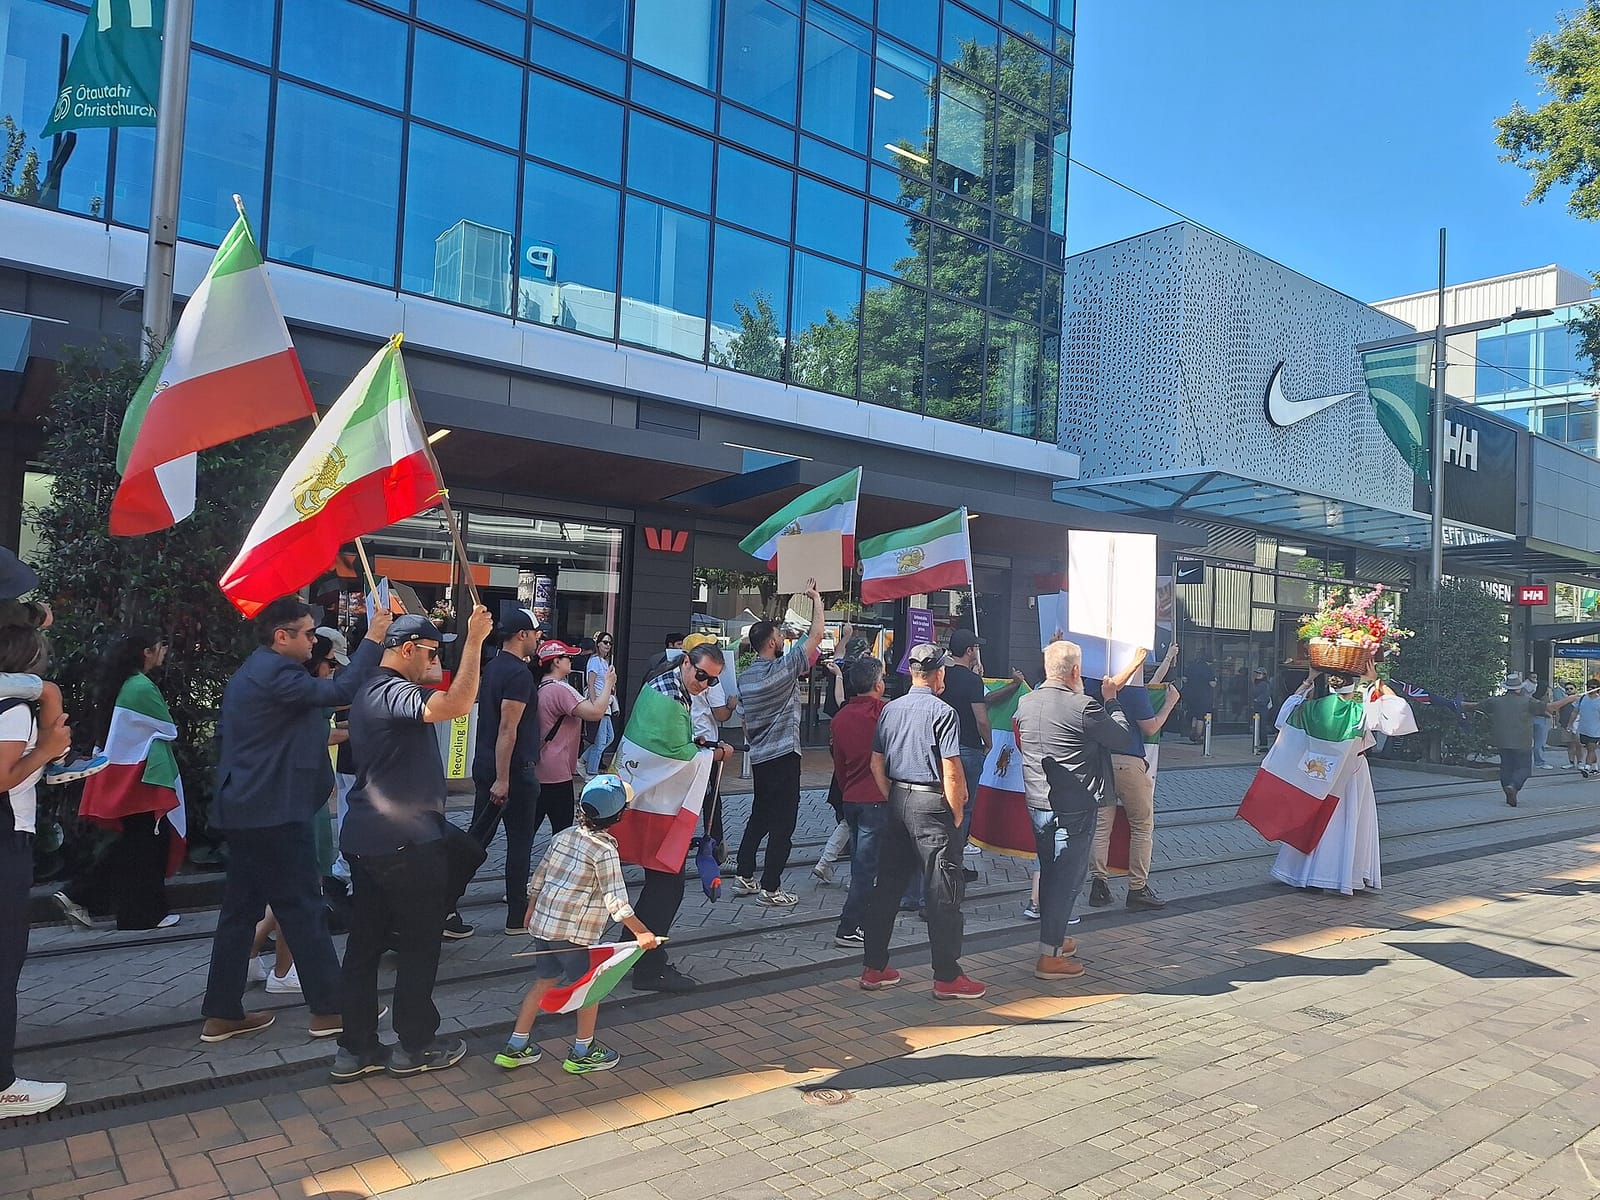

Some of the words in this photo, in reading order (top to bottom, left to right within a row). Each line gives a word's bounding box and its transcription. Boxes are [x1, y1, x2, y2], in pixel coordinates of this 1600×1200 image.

[76, 83, 132, 101] Ōtautahi
[74, 101, 157, 118] Christchurch
[1443, 418, 1479, 472] HH
[1522, 589, 1545, 601] HH
[452, 730, 467, 777] Recycling
[0, 1094, 30, 1103] HOKA
